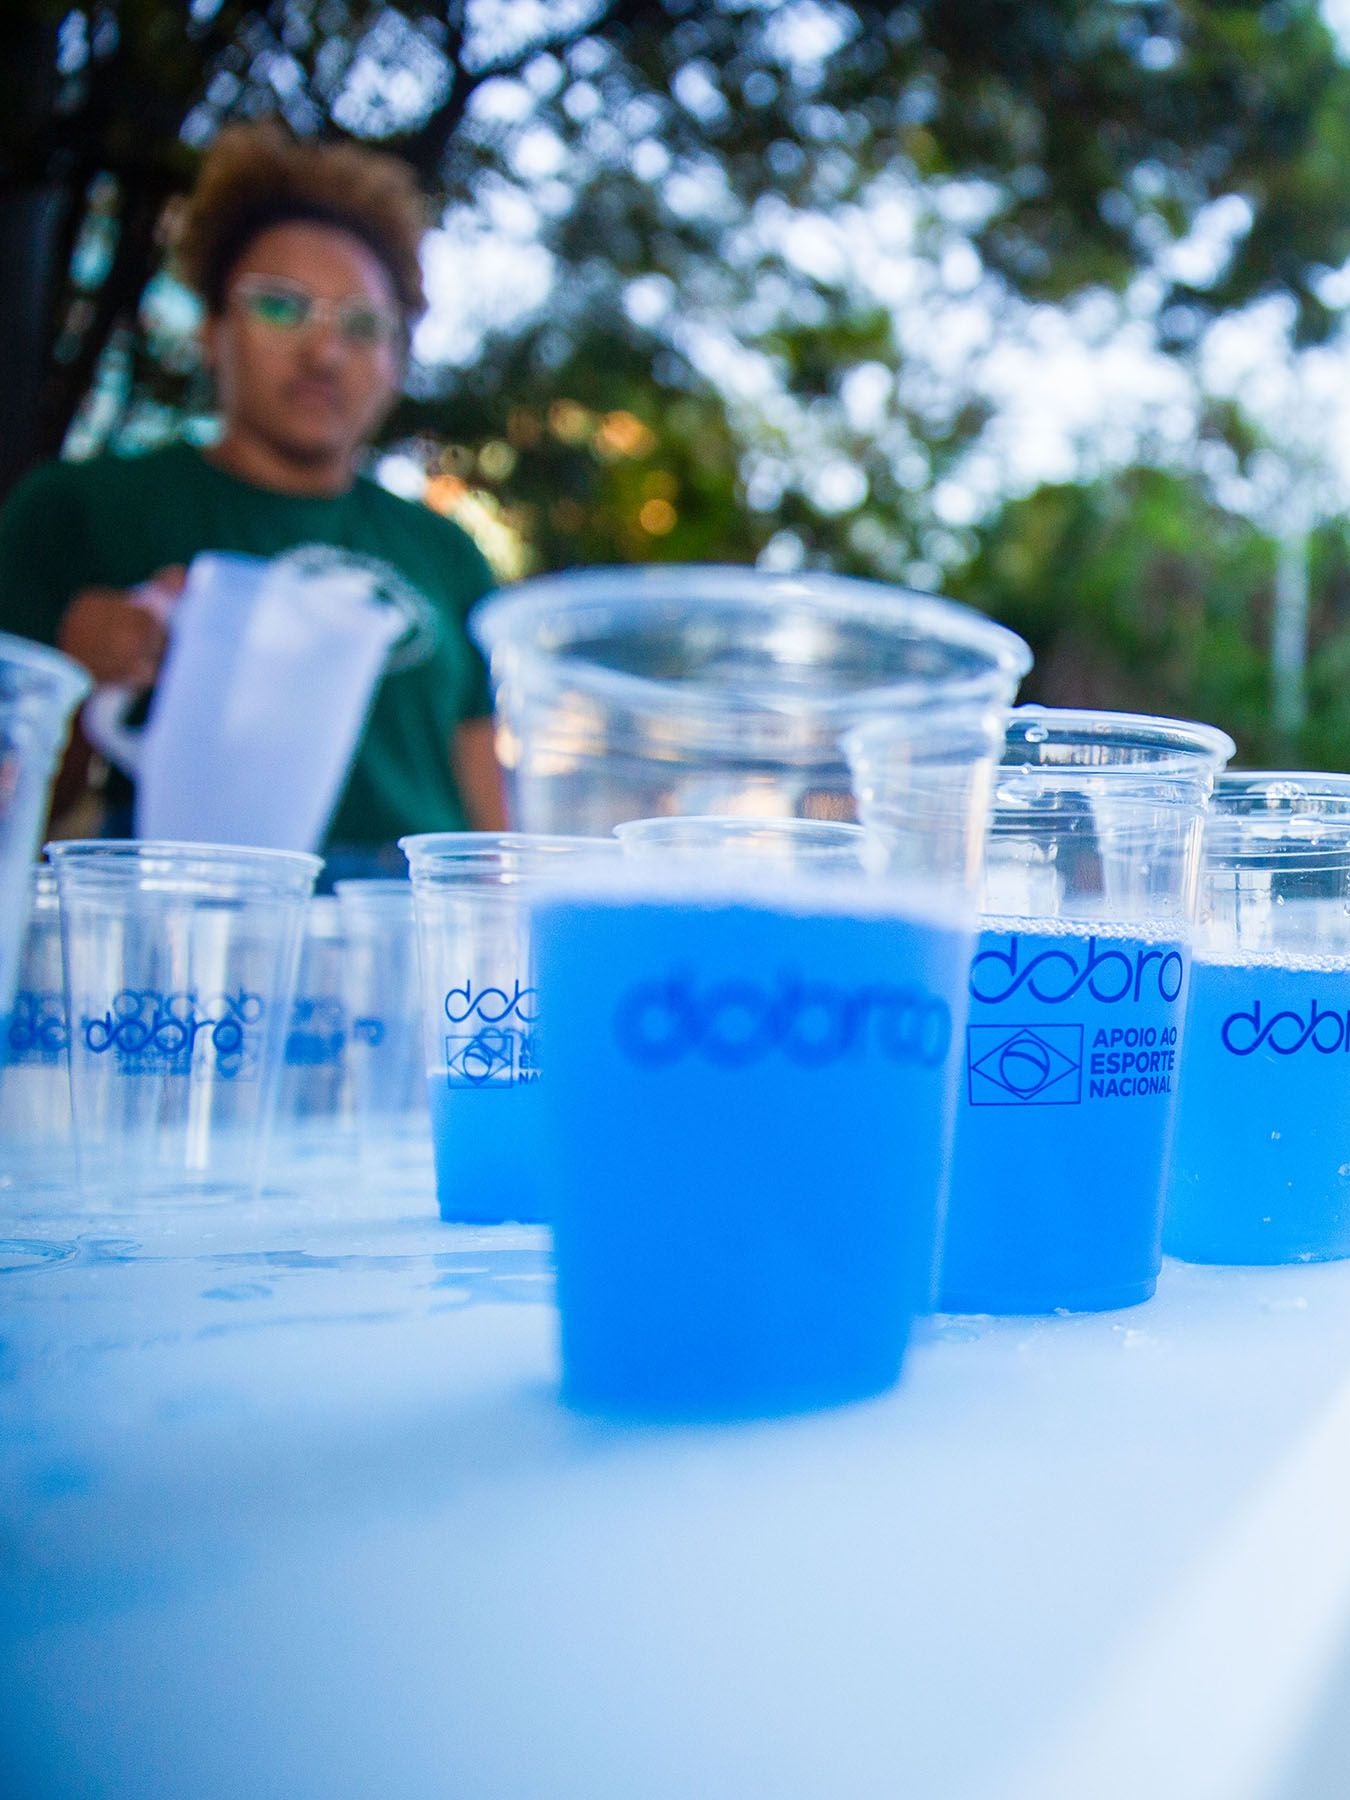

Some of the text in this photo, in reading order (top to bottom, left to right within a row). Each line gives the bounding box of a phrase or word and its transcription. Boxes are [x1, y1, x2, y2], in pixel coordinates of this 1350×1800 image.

[968, 936, 1184, 1003] dobro
[86, 1011, 243, 1054] dobro
[1092, 1026, 1178, 1049] APOIO AO
[1090, 1050, 1176, 1075] ESPORTE
[1089, 1075, 1172, 1098] NACIONAL
